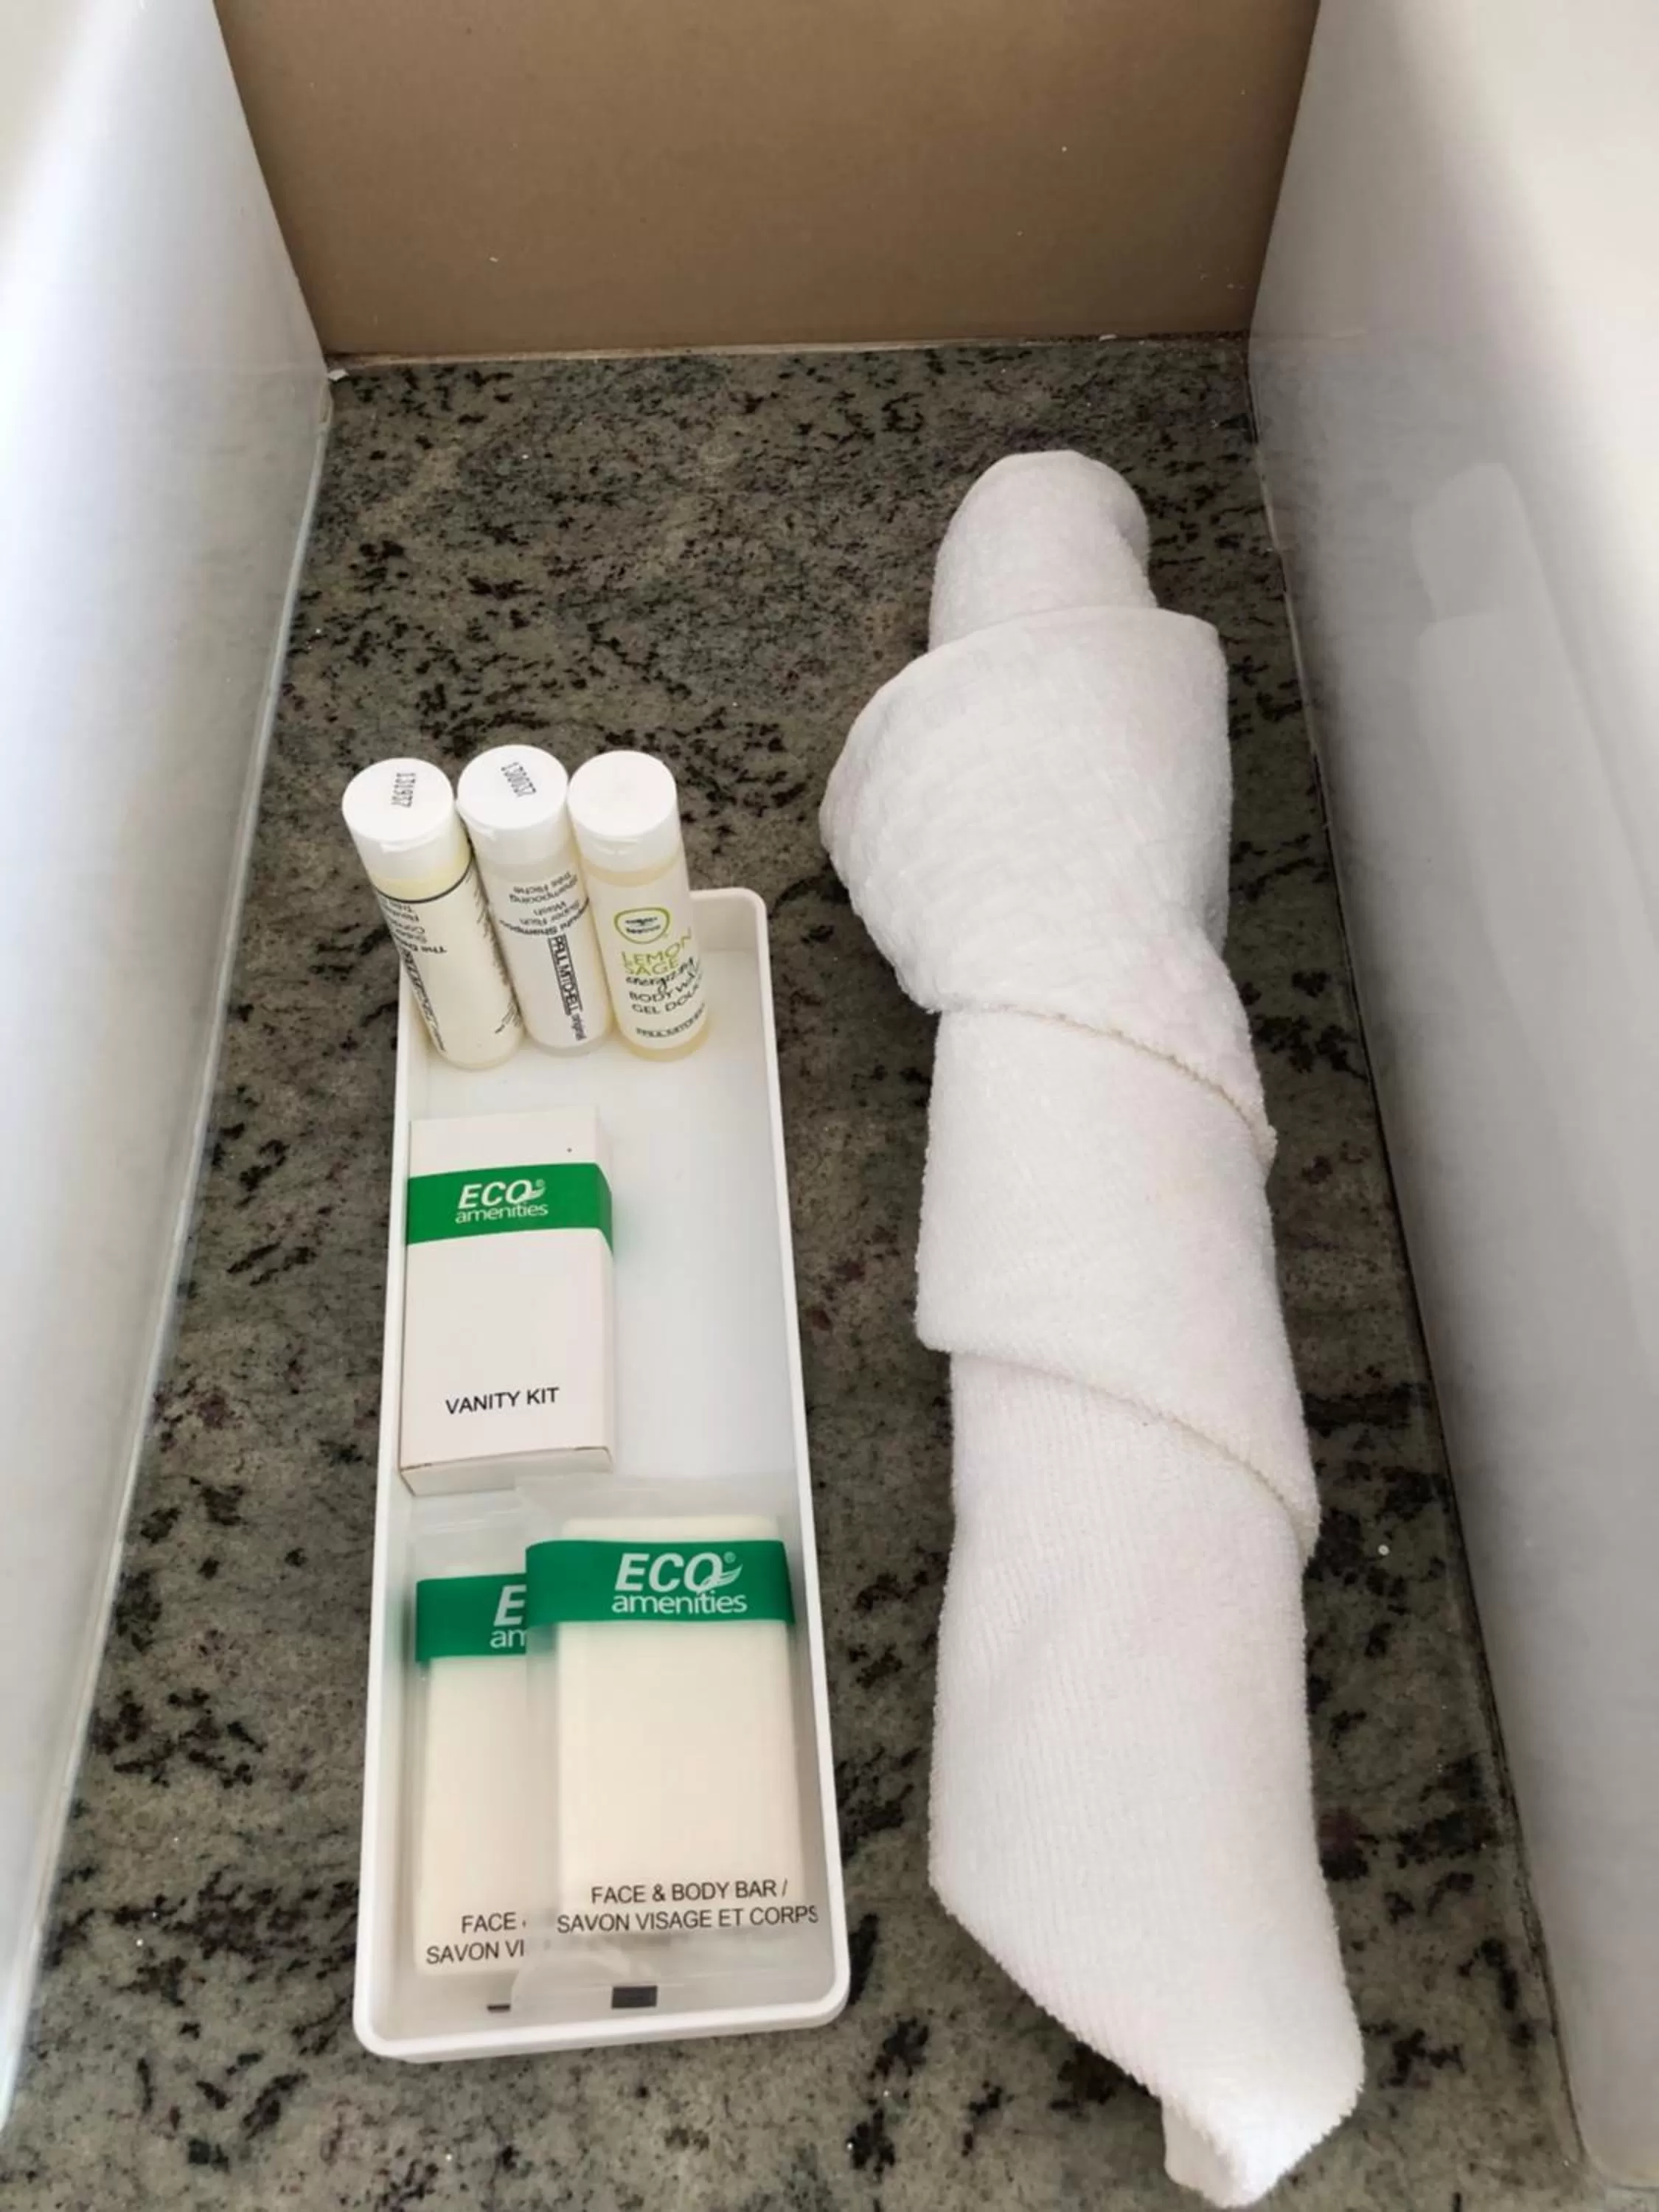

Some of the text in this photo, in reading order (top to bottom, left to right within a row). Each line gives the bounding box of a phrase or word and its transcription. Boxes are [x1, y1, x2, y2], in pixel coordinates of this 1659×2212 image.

[622, 926, 692, 972] LEMON
[625, 958, 679, 976] SAGE
[631, 1003, 660, 1015] GEL
[458, 1179, 546, 1210] ECO
[454, 1203, 549, 1224] amenities
[445, 1386, 560, 1414] VANITY KIT
[614, 1552, 742, 1593] ECO
[611, 1590, 748, 1615] amenities
[591, 1885, 647, 1905] FACE
[651, 1884, 666, 1902] &
[672, 1881, 730, 1902] BODY
[734, 1879, 777, 1899] BAR
[461, 1911, 517, 1934] FACE
[557, 1905, 820, 1934] SAVON VISAGE ET CORPS
[425, 1938, 500, 1965] SAVON
